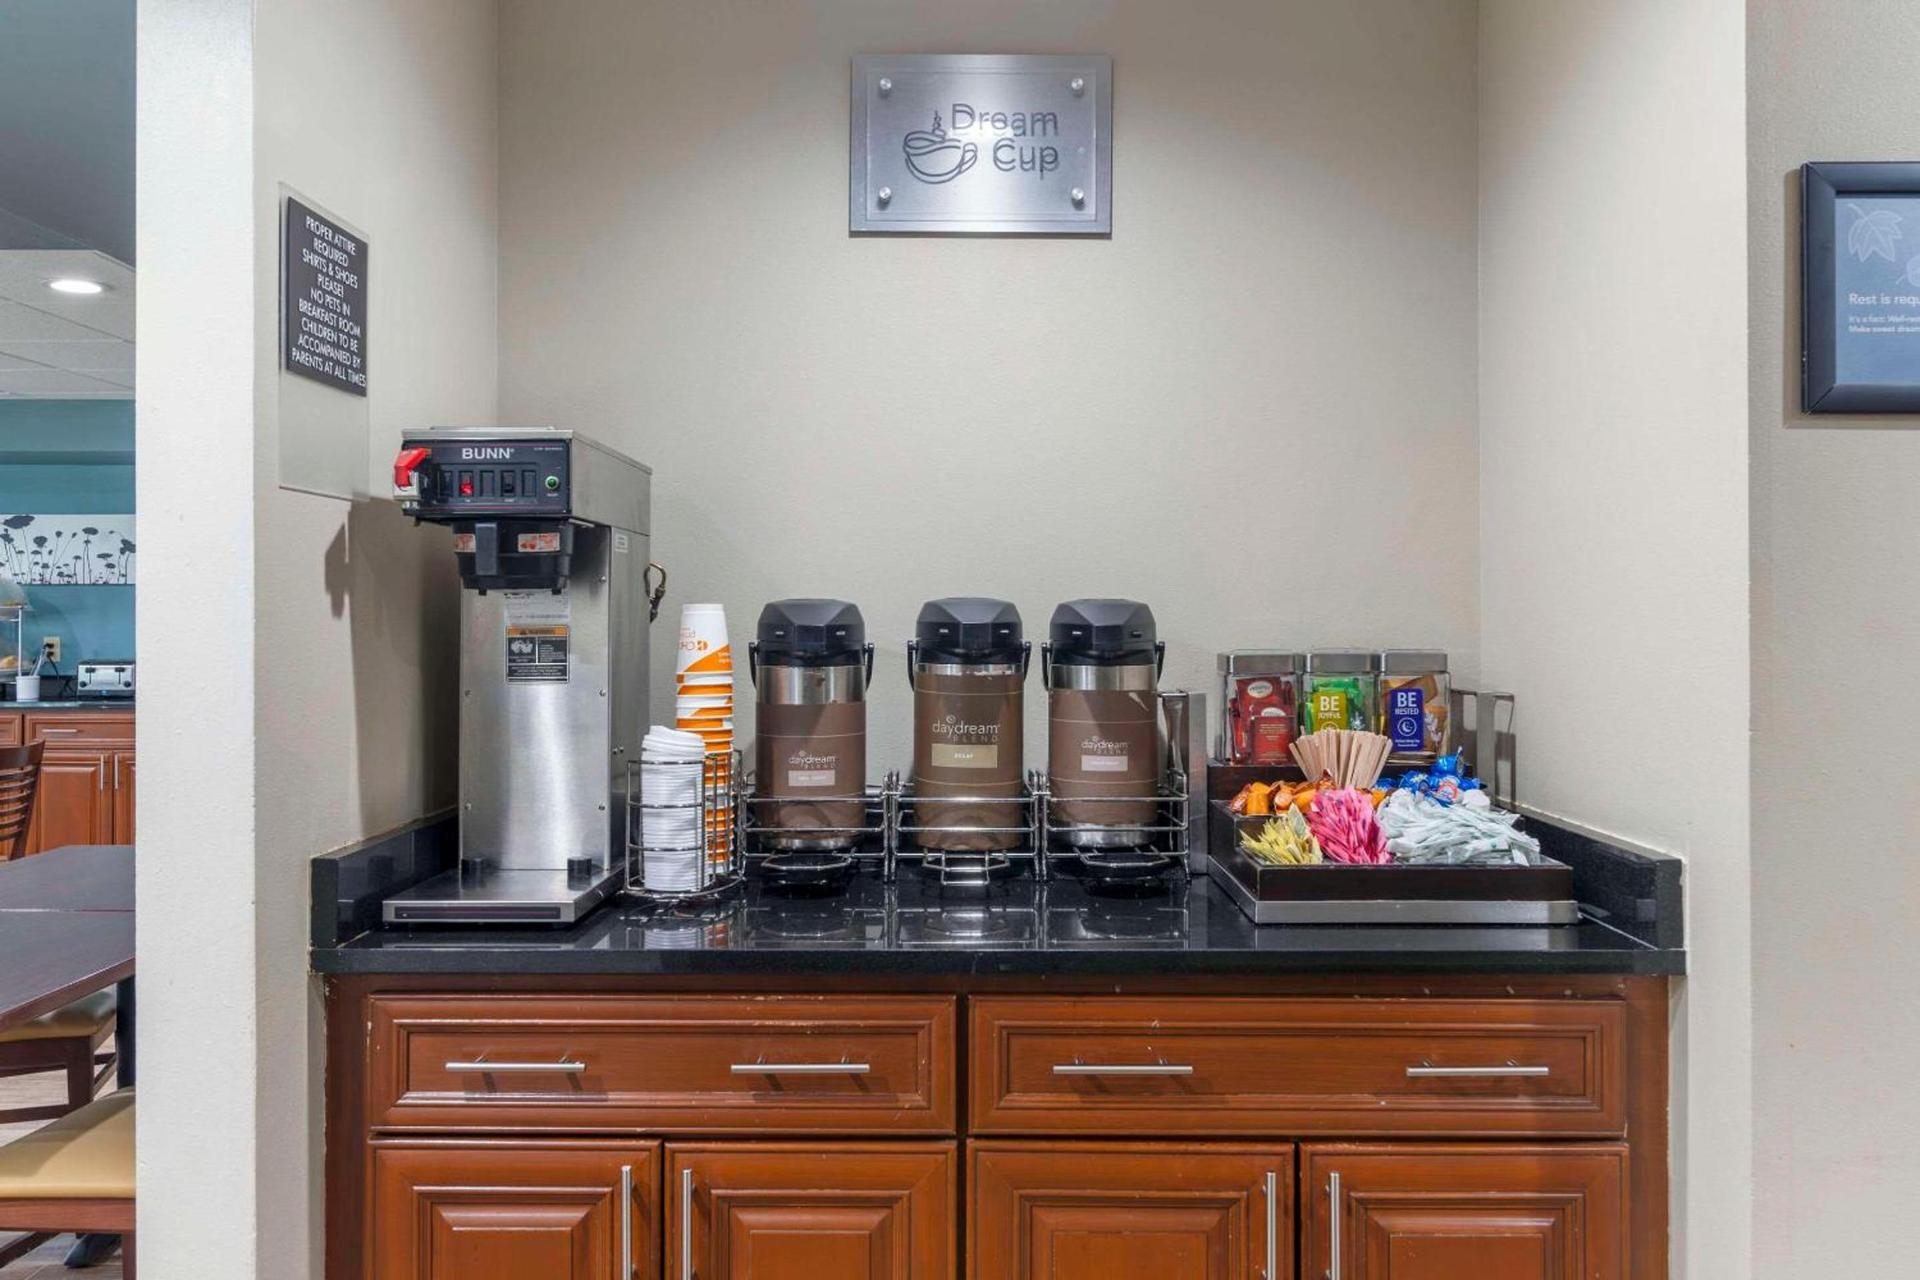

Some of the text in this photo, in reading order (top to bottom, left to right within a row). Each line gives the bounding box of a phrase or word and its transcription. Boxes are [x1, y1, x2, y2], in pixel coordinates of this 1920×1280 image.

[951, 103, 1059, 135] Dream
[993, 138, 1059, 178] Cup
[306, 215, 357, 256] PROPER ATTIRE
[313, 237, 349, 267] REQUIRED
[302, 248, 327, 273] SHIRTS
[335, 266, 358, 289] SHOES
[298, 298, 337, 327] BREAKFAST
[310, 287, 351, 318] NO PETS IN
[1849, 293, 1877, 304] Rest
[1880, 293, 1891, 304] is
[297, 333, 352, 365] ACCOMPANIED
[301, 317, 358, 353] CHILDREN TO BE
[291, 347, 367, 387] PARENTS AT ALL TIMES
[462, 447, 511, 459] BUNN
[1320, 695, 1341, 711] BE
[1394, 707, 1420, 715] RESTED
[1397, 691, 1418, 708] BE
[932, 719, 998, 739] daydream
[1317, 711, 1342, 720] JOYFUL
[1081, 738, 1129, 752] daydream
[788, 752, 836, 768] daydream
